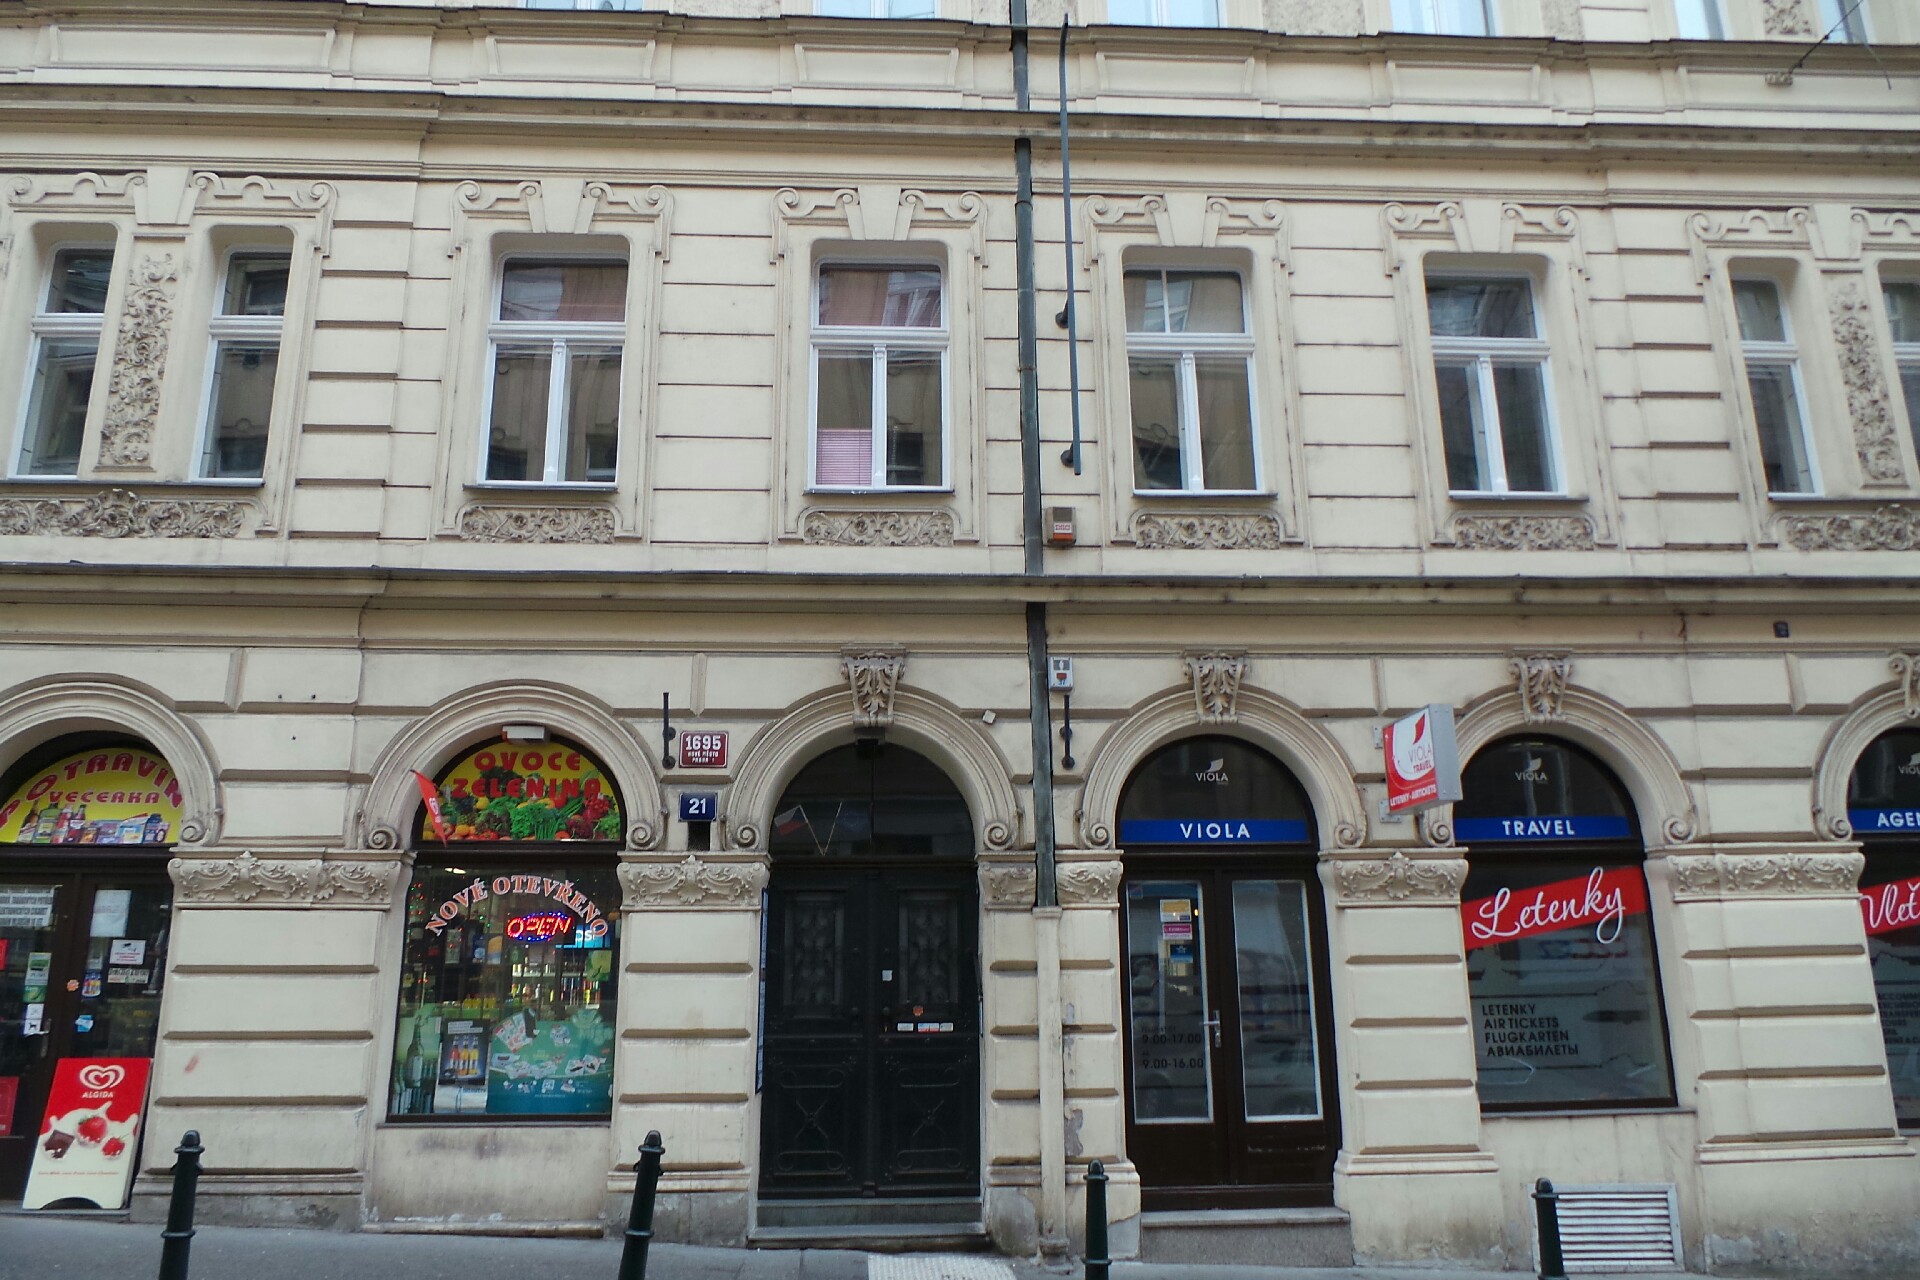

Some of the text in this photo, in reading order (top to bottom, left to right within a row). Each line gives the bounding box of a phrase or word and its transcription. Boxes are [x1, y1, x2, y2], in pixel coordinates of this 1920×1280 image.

[685, 735, 722, 750] 1695
[1408, 743, 1433, 763] VIOLA
[474, 752, 581, 771] OVOCE
[1195, 772, 1229, 782] VIOLA
[1514, 771, 1548, 781] VIOLA
[452, 778, 601, 799] ZELENINA
[688, 798, 706, 814] 21
[1502, 820, 1575, 836] TRAVEL
[1877, 812, 1920, 828] AGE
[1180, 823, 1250, 839] VIOLA
[425, 874, 609, 937] NOVÉ OTEVŘENO
[1471, 866, 1626, 944] Letenky
[507, 915, 573, 938] OPEN
[1482, 1004, 1536, 1015] LETENKY
[1484, 1016, 1559, 1029] AIR TICKETS
[1485, 1030, 1569, 1043] FLUGKARTEN
[1487, 1043, 1579, 1057] АВИАБИЛЕТЫ
[1142, 1058, 1204, 1069] 9.00-16.00
